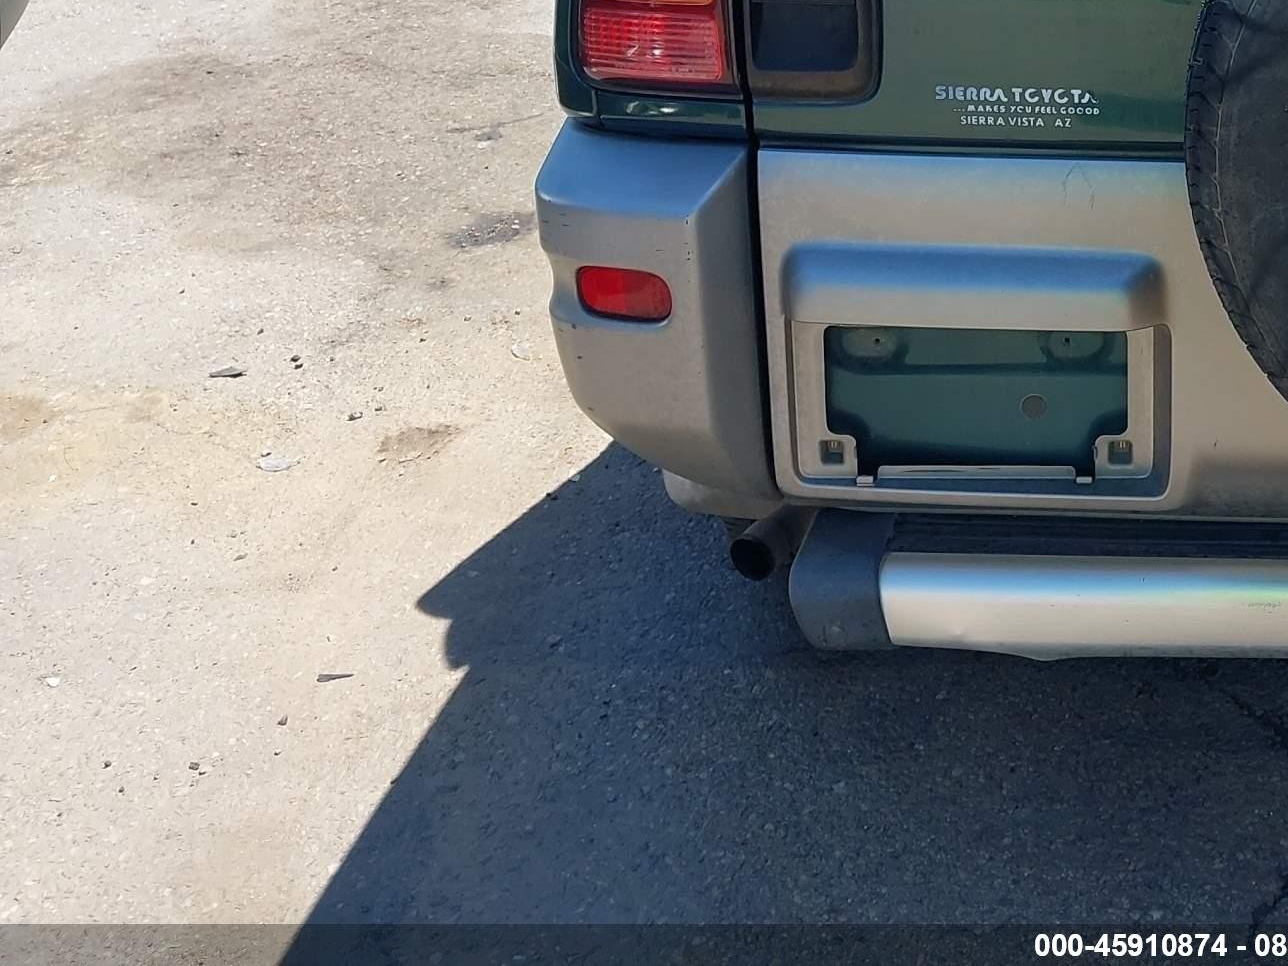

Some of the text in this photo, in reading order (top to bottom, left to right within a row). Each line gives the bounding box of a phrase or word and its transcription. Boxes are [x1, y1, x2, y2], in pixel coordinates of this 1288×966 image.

[935, 85, 1009, 103] SIERRA
[1034, 105, 1057, 115] FEEL
[1060, 106, 1100, 116] GOOOD
[960, 115, 1072, 128] SIERRA VISTA AZ
